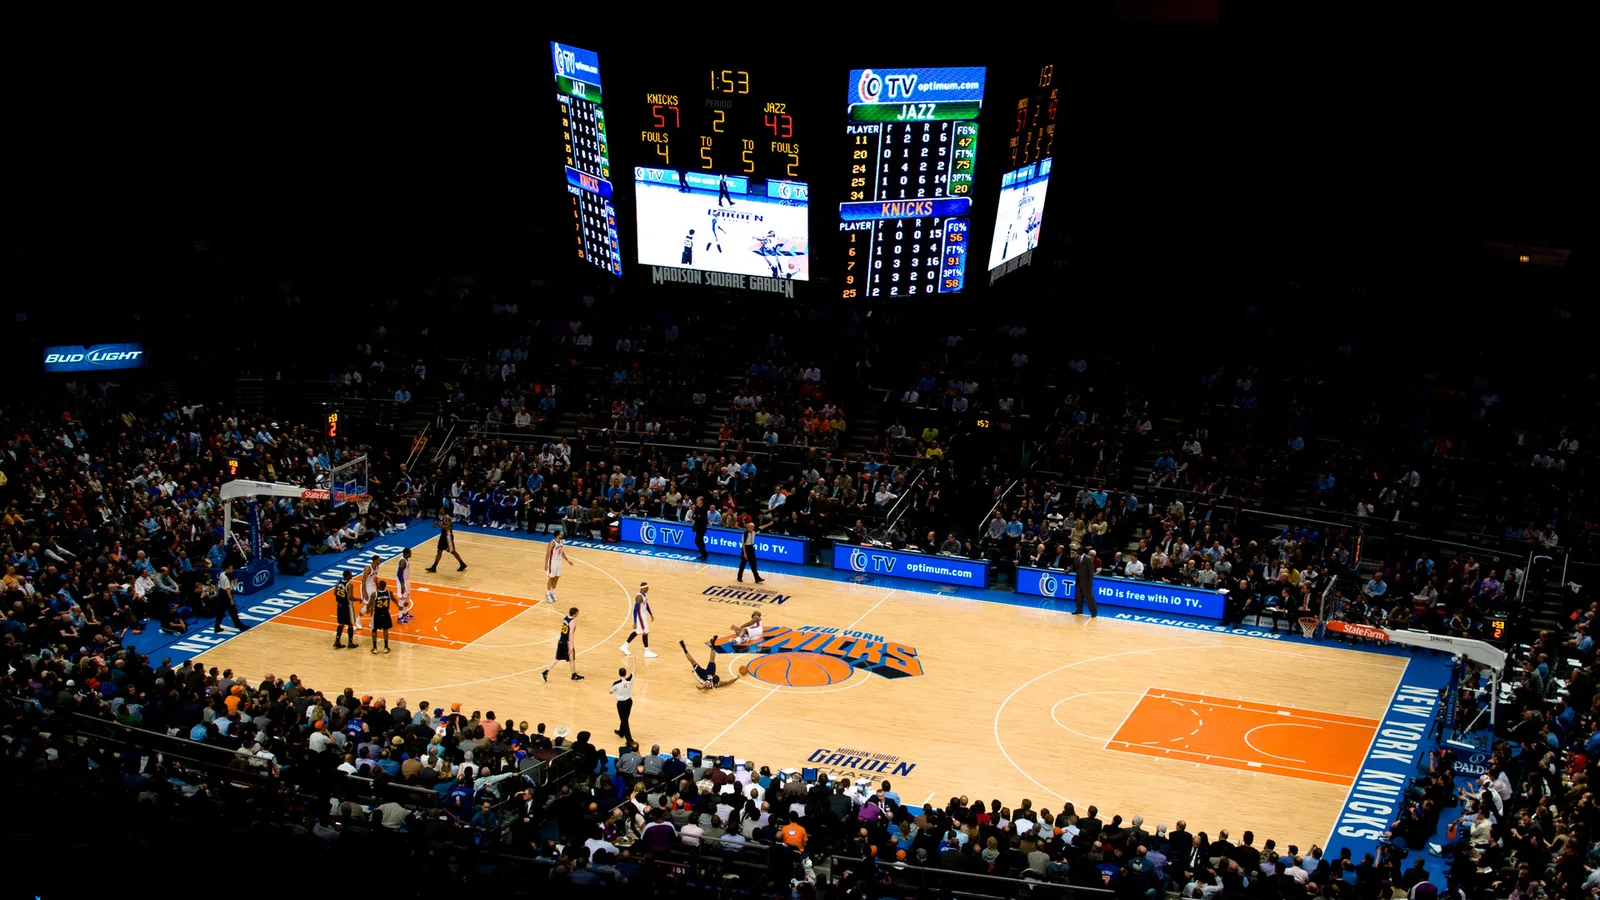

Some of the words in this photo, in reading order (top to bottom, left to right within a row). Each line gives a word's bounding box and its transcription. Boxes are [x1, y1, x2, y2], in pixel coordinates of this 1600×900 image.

[711, 70, 749, 94] 1:53
[885, 75, 917, 98] TV
[918, 81, 979, 92] optimum.com
[647, 93, 679, 106] KNICKS
[705, 99, 732, 109] PERIOD
[763, 102, 786, 114] JAZZ
[897, 104, 936, 120] JAZZ
[652, 105, 679, 128] 57
[713, 110, 725, 133] 2
[764, 115, 793, 138] 43
[847, 125, 879, 134] PLAYER
[887, 124, 892, 132] F
[904, 124, 911, 132] A
[924, 123, 930, 132] R
[957, 126, 976, 135] FG%
[641, 131, 669, 143] FOULS
[700, 135, 712, 147] TO
[855, 136, 867, 145] 11
[886, 135, 891, 144] 1
[904, 134, 911, 143] 2
[922, 134, 930, 142] 0
[940, 133, 947, 142] 6
[958, 138, 972, 146] 47
[742, 139, 754, 151] TO
[771, 141, 799, 154] FOULS
[656, 144, 669, 164] 4
[700, 147, 713, 169] 5
[853, 150, 868, 159] 20
[884, 150, 891, 158] 0
[903, 149, 909, 157] 1
[921, 148, 929, 157] 2
[938, 147, 946, 156] 5
[955, 150, 974, 158] FT%
[742, 150, 754, 173] 5
[787, 154, 799, 176] 2
[852, 164, 866, 173] 24
[883, 164, 889, 172] 1
[901, 163, 908, 171] 4
[919, 162, 927, 171] 2
[937, 161, 945, 170] 2
[956, 160, 970, 169] 75
[851, 178, 866, 187] 25
[882, 177, 888, 185] 1
[900, 176, 907, 185] 0
[918, 175, 926, 184] 6
[934, 175, 947, 183] 14
[952, 174, 972, 182] 3PT%
[850, 191, 864, 200] 34
[881, 190, 887, 199] 1
[900, 189, 906, 198] 1
[918, 189, 925, 197] 2
[935, 188, 942, 197] 2
[954, 185, 968, 193] 20
[881, 202, 933, 217] KNICKS
[839, 222, 871, 231] PLAYER
[878, 221, 884, 229] F
[896, 220, 903, 228] A
[916, 219, 921, 227] R
[934, 218, 940, 226] P
[948, 223, 967, 232] FG%
[850, 234, 856, 242] 1
[877, 232, 883, 241] 1
[895, 231, 902, 240] 0
[914, 230, 921, 239] 0
[929, 230, 942, 238] 15
[950, 233, 963, 242] 56
[848, 248, 856, 256] 6
[876, 246, 882, 255] 1
[894, 246, 901, 254] 0
[913, 245, 920, 253] 3
[930, 244, 937, 252] 4
[946, 246, 964, 254] FT%
[847, 262, 855, 270] 7
[874, 260, 882, 269] 0
[893, 260, 900, 268] 3
[912, 258, 919, 267] 3
[926, 257, 939, 266] 16
[947, 258, 960, 266] 91
[652, 265, 702, 285] MADISON
[705, 269, 746, 289] SQUARE
[750, 276, 794, 298] GARDEN
[847, 276, 854, 284] 9
[874, 274, 880, 283] 1
[892, 273, 899, 282] 3
[910, 272, 918, 281] 2
[927, 271, 935, 280] 0
[945, 280, 959, 288] 58
[842, 289, 856, 298] 25
[872, 288, 880, 297] 2
[890, 286, 898, 295] 2
[909, 286, 916, 294] 2
[926, 284, 933, 293] 0
[44, 354, 84, 363] BUD
[92, 351, 142, 361] LIGHT
[329, 423, 336, 437] 2
[230, 467, 236, 475] 2
[661, 528, 684, 545] TV
[710, 536, 718, 545] is
[720, 538, 737, 547] free
[772, 545, 788, 554] TV.
[872, 554, 896, 572] TV
[906, 562, 972, 578] optimum.com
[238, 588, 318, 622] YORK
[306, 544, 406, 586] KNICKS
[256, 573, 267, 583] KIA
[336, 587, 346, 598] 25
[702, 586, 792, 605] GARDEN
[1064, 580, 1076, 595] T
[1098, 586, 1113, 597] HD
[1116, 588, 1124, 598] is
[1126, 590, 1146, 602] free
[1148, 592, 1169, 604] with
[1185, 597, 1202, 608] TV.
[376, 600, 388, 608] 24
[708, 598, 763, 607] CHASE
[1115, 613, 1282, 639] NYKNICKS.COM
[797, 625, 840, 634] NEW
[843, 630, 884, 642] YORK
[1494, 628, 1500, 638] 2
[1392, 684, 1440, 718] NEW
[1370, 720, 1426, 764] YORK
[836, 747, 870, 757] MADISON
[872, 752, 901, 762] SQUARE
[807, 748, 917, 776] GARDEN
[817, 766, 884, 782] CHASE
[1337, 768, 1406, 840] KNICKS
